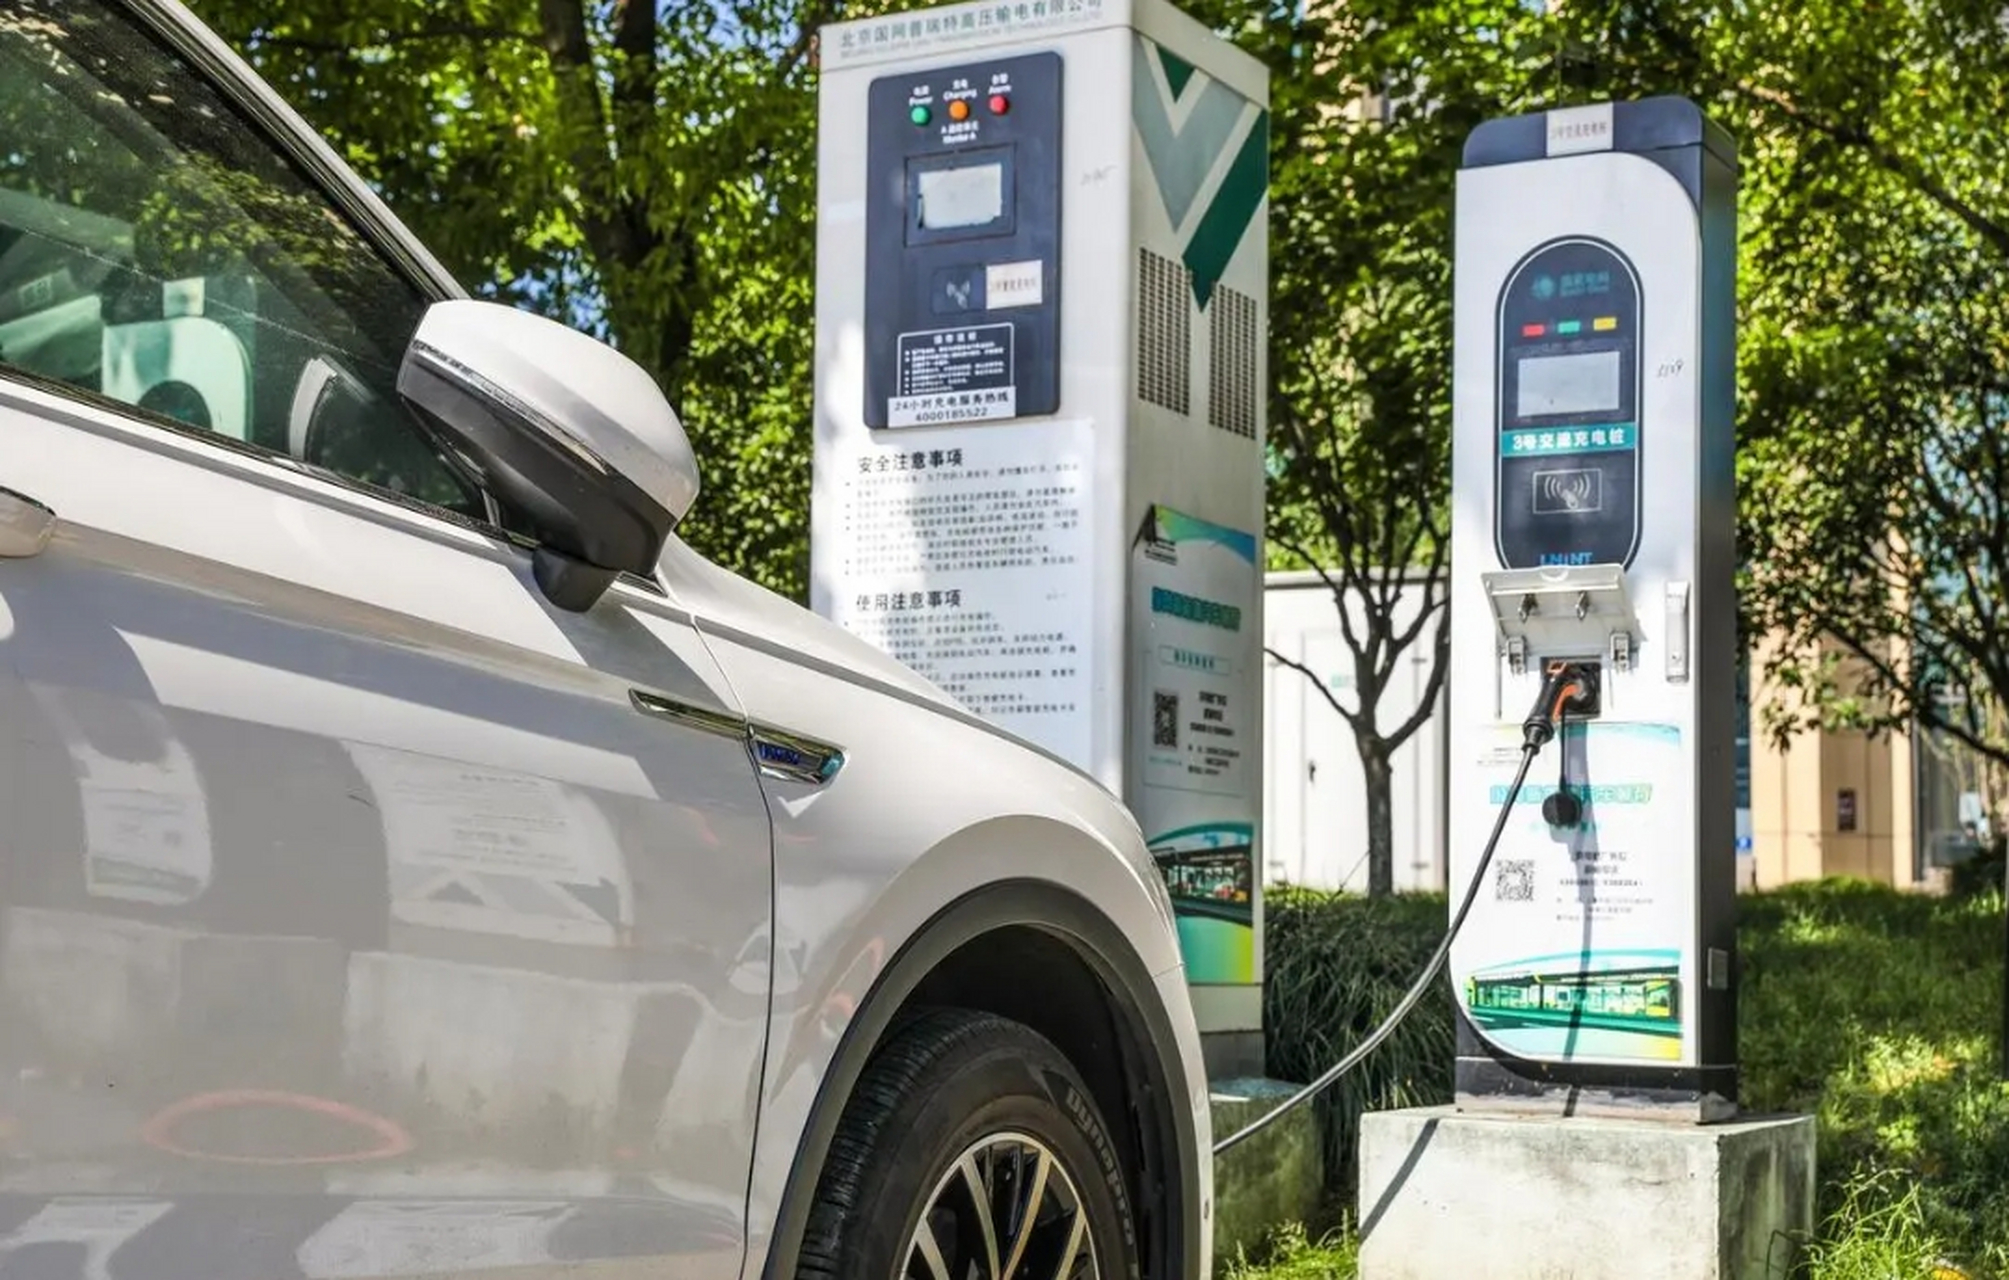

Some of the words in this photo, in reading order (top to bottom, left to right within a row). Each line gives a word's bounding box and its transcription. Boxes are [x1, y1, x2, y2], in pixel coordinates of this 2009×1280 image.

[857, 448, 963, 474] 安全注意事项
[856, 588, 962, 612] 使用注意事项
